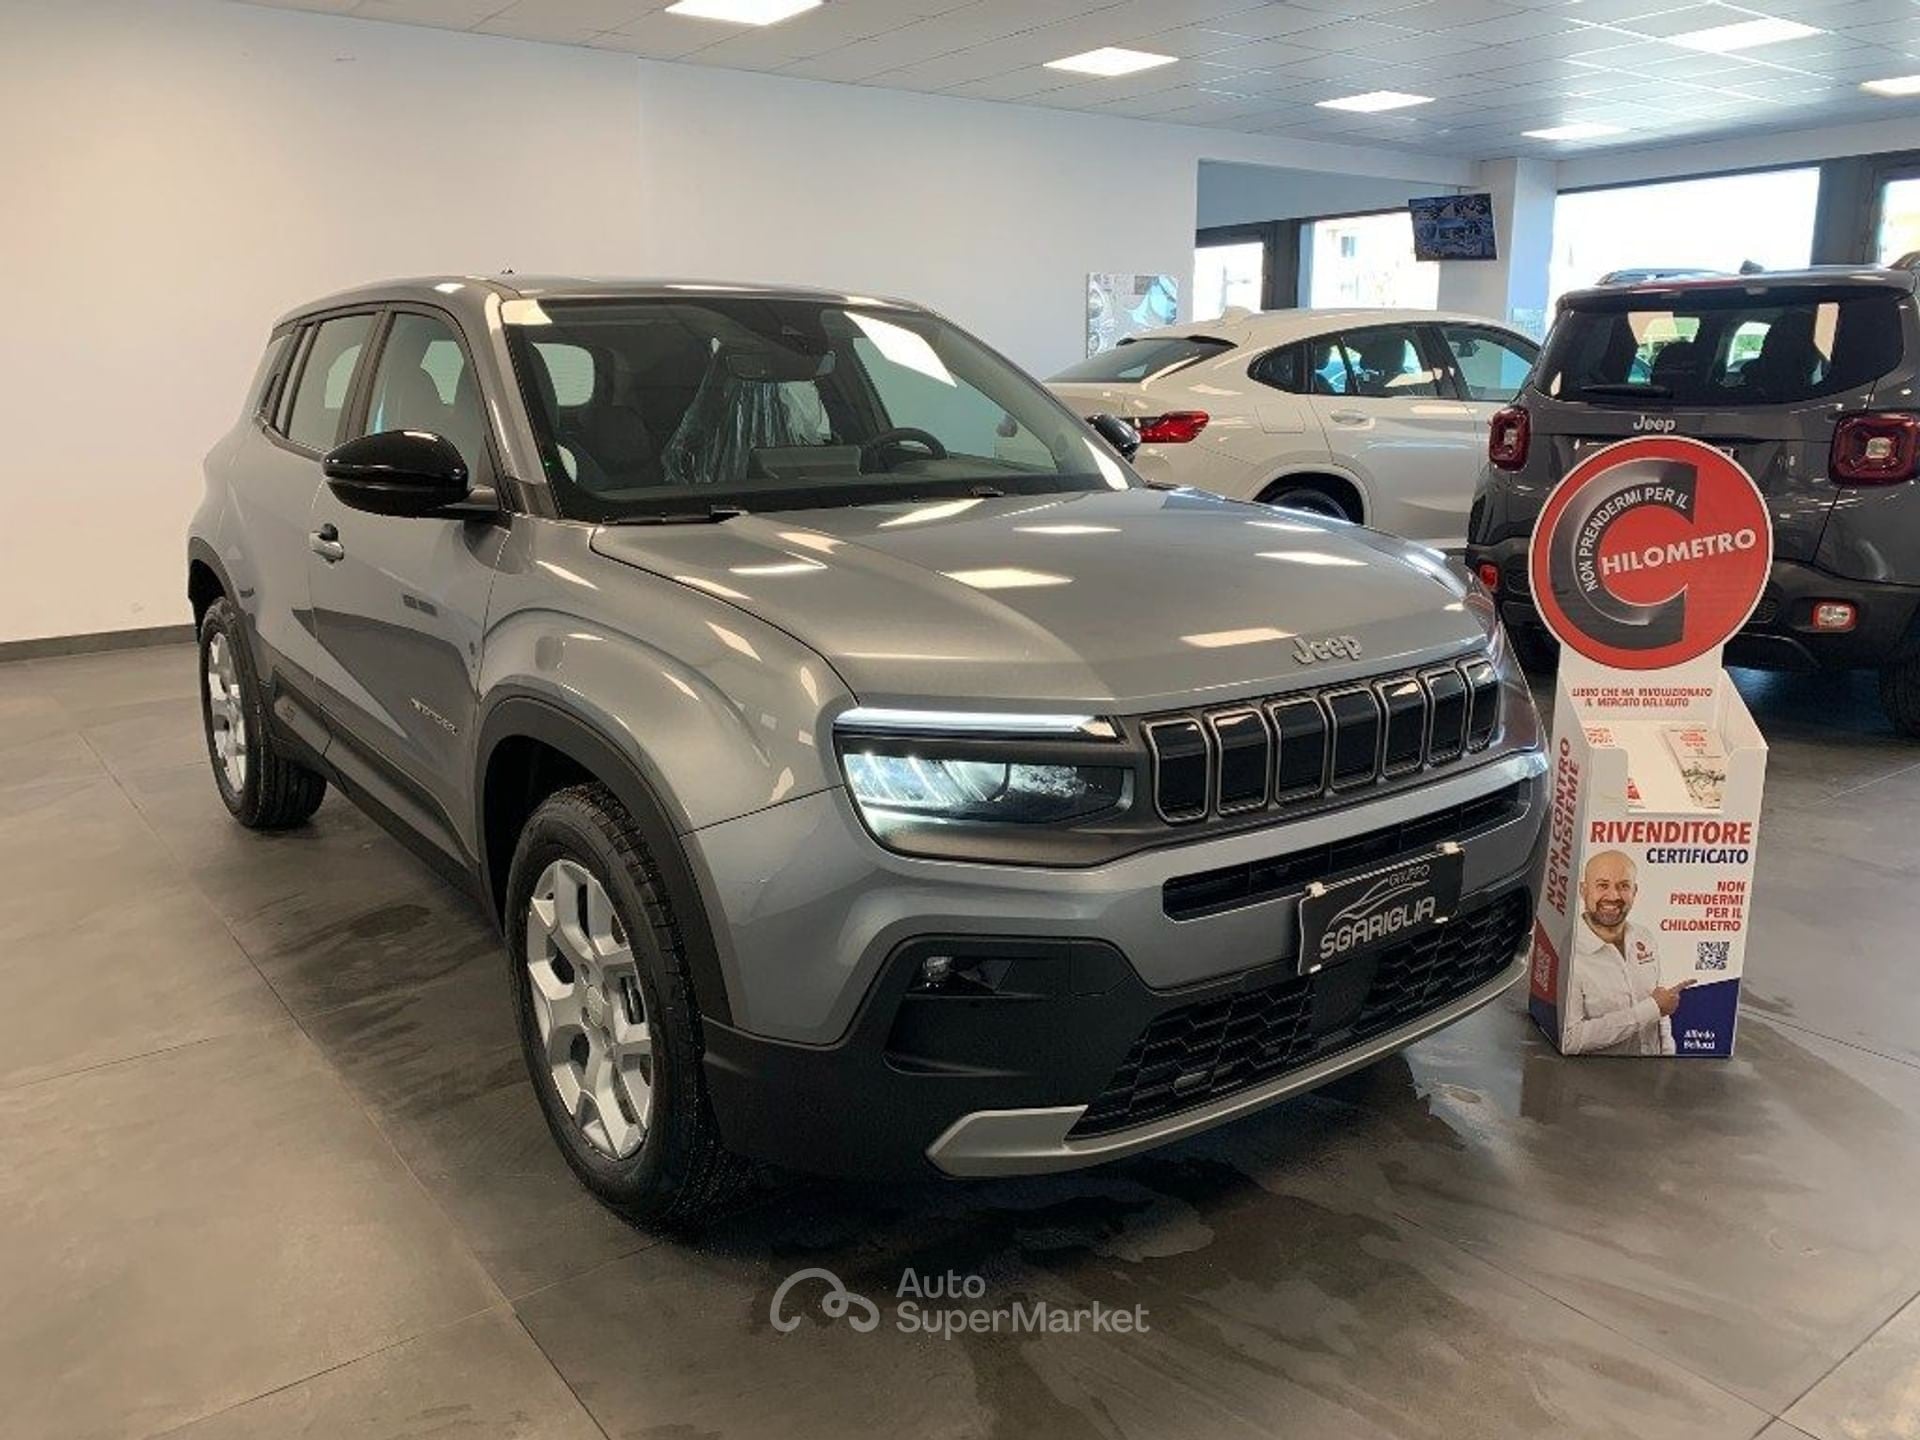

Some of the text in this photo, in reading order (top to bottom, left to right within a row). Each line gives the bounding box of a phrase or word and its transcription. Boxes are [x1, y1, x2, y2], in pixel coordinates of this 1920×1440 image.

[1633, 414, 1676, 434] Jeep
[1579, 487, 1689, 592] NON PRENDERMI PER IL
[1600, 528, 1757, 576] HILOMETRO
[1291, 635, 1362, 665] Jeep
[1572, 687, 1713, 698] LIBRO CHE HA RIVOLUZIONATO
[1597, 698, 1640, 708] MERCATO
[1546, 736, 1571, 905] NON CONTRO
[1556, 759, 1579, 916] MA INSIEME
[1589, 820, 1753, 845] RIVENDITORE
[1646, 847, 1749, 865] CERTIFICATO
[1717, 881, 1745, 892] NON
[1670, 893, 1744, 906] PRENDERMI
[1706, 907, 1743, 919] PER IL
[1319, 896, 1436, 960] SGARIGLIA
[1660, 918, 1741, 932] CHILOMETRO
